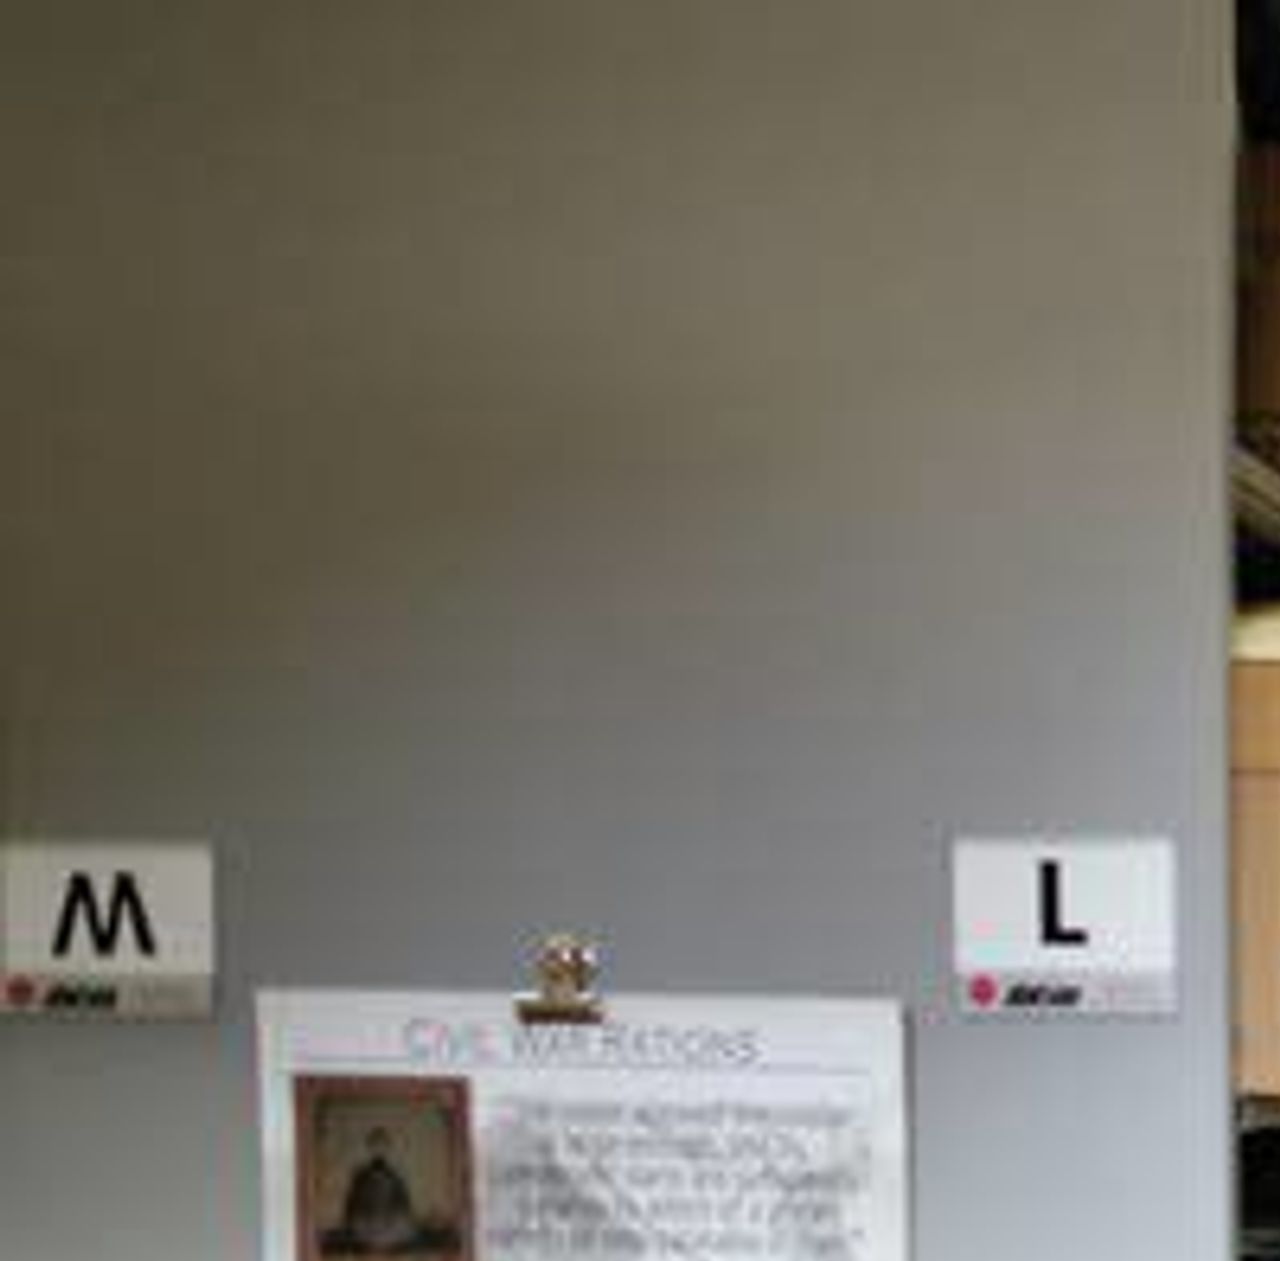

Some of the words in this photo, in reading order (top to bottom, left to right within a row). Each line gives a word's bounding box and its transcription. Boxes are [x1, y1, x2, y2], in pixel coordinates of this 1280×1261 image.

[52, 869, 156, 957] M
[1040, 859, 1088, 946] L
[600, 1023, 761, 1066] RATIONS
